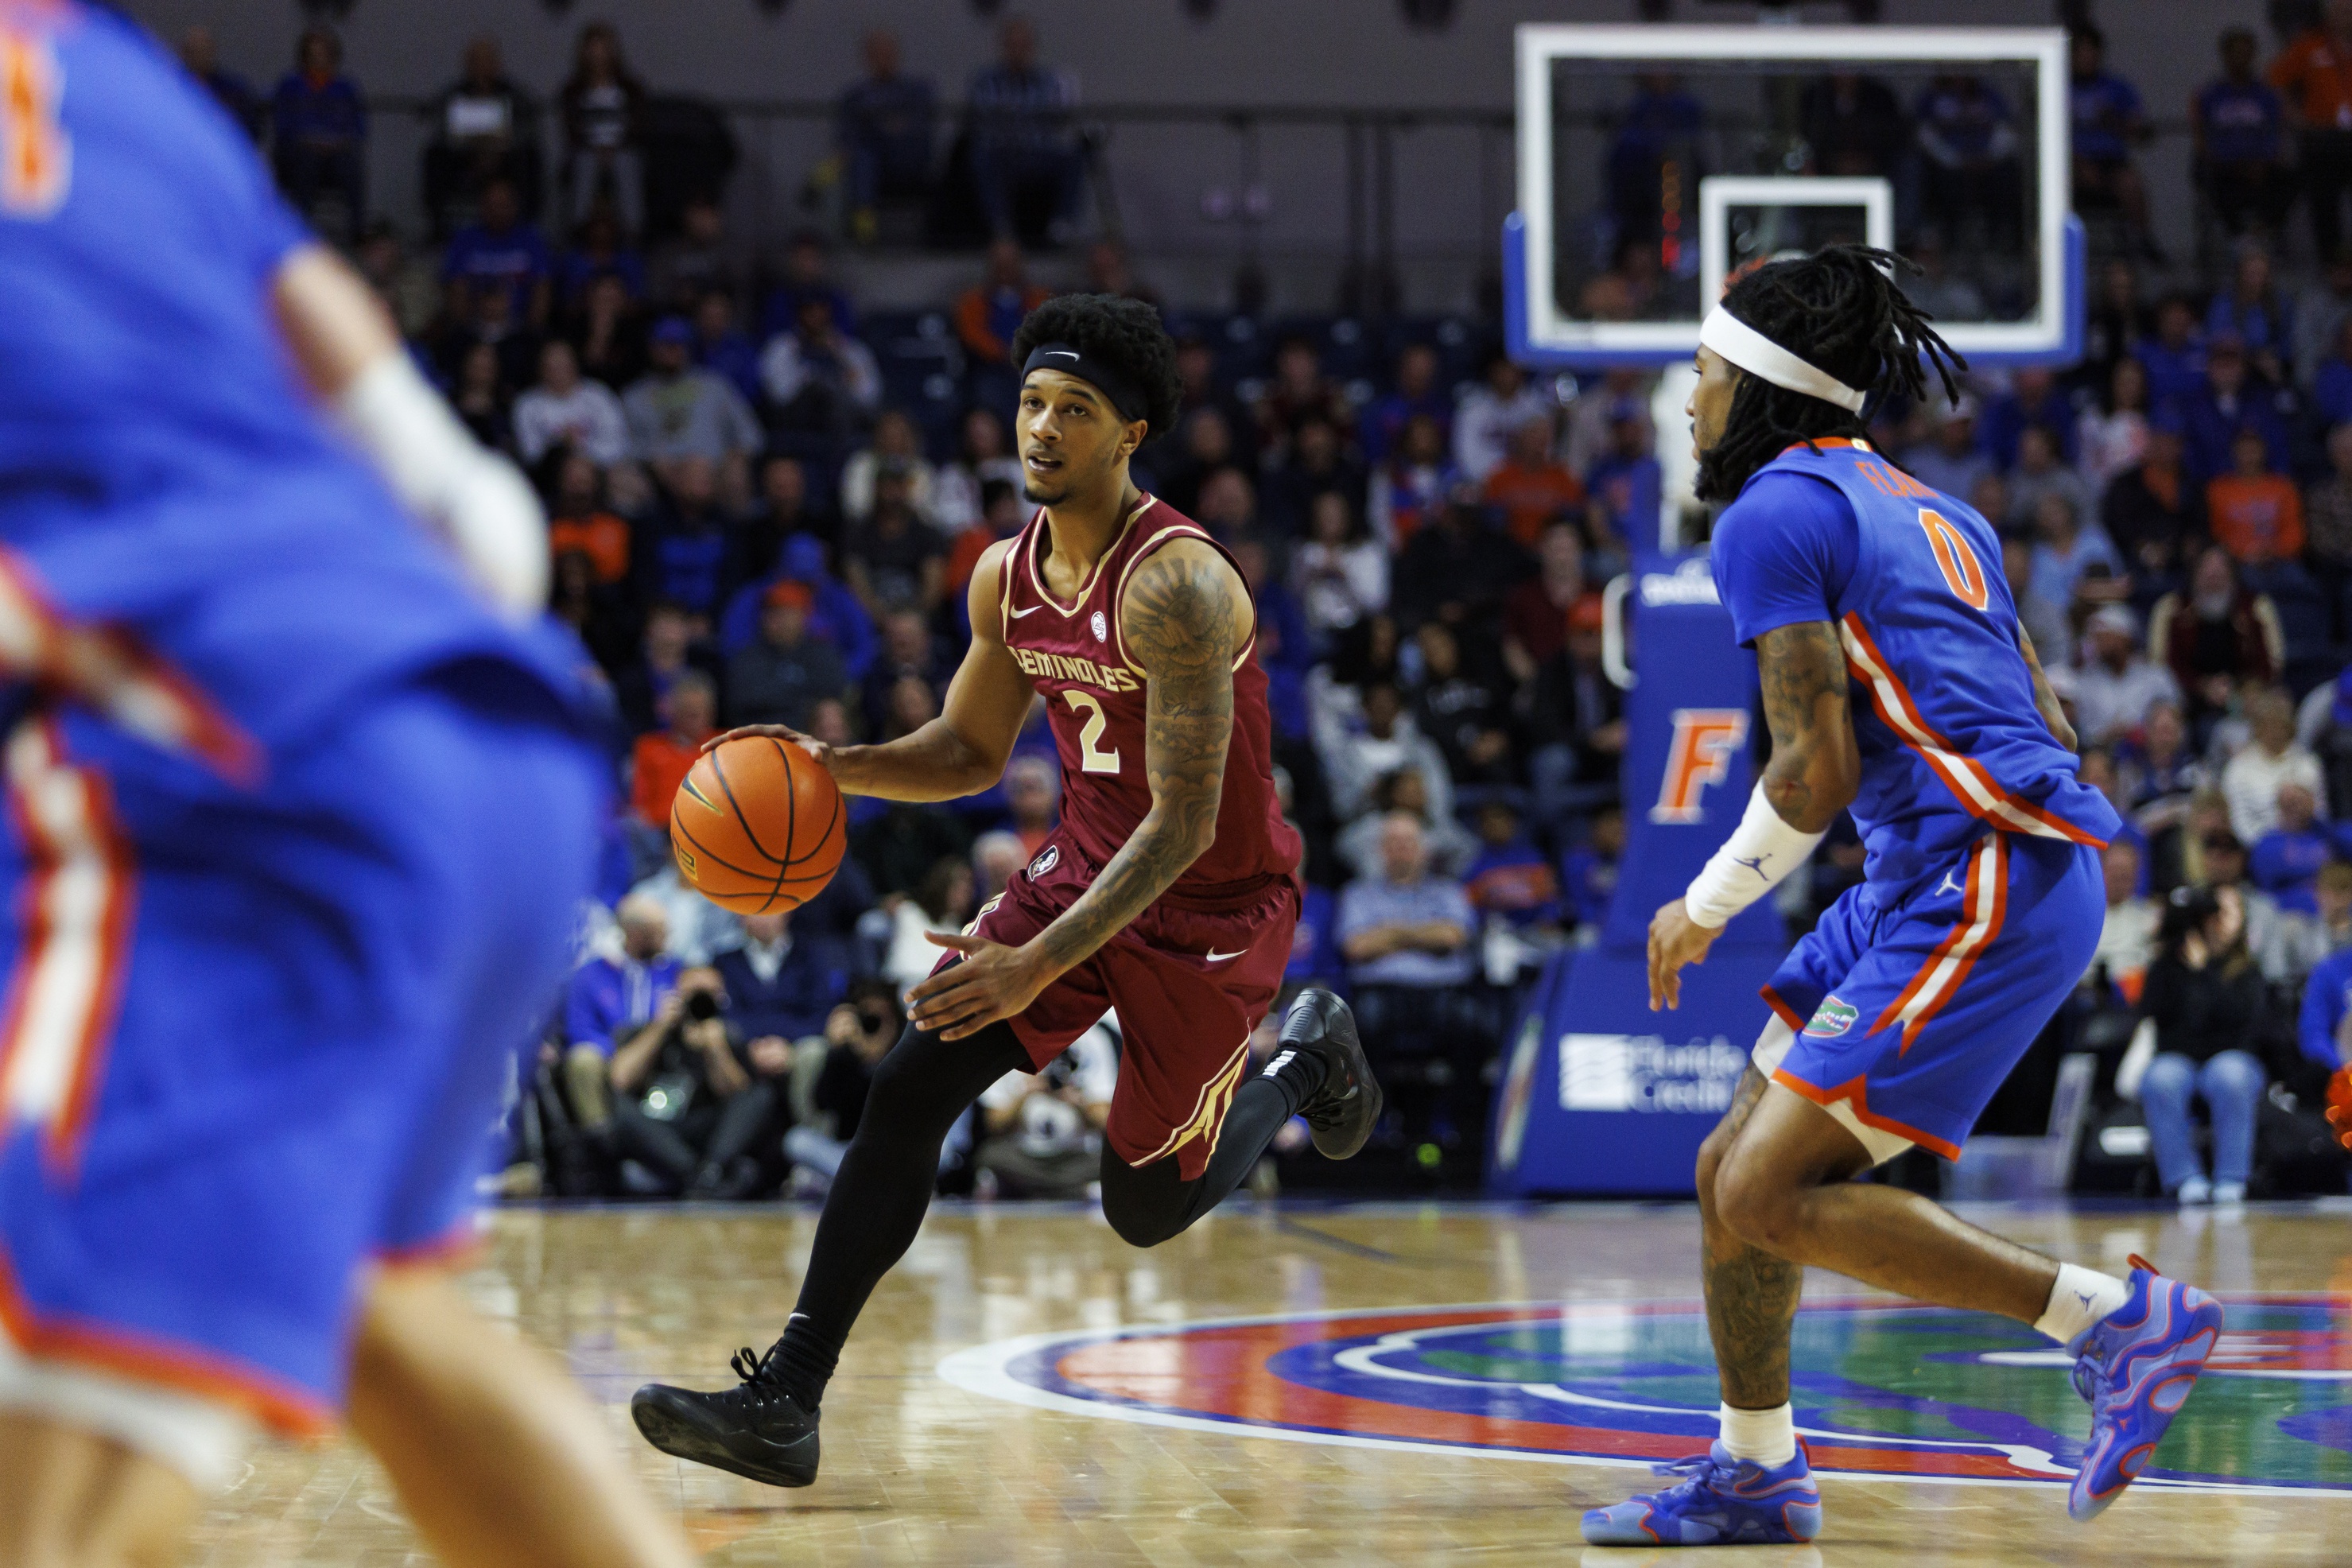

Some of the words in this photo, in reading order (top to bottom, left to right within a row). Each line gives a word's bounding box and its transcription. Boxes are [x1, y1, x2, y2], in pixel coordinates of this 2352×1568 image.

[1918, 507, 1988, 611] 0
[1062, 689, 1120, 774] 2
[1649, 708, 1751, 825] F
[1628, 1035, 1747, 1076] Florida
